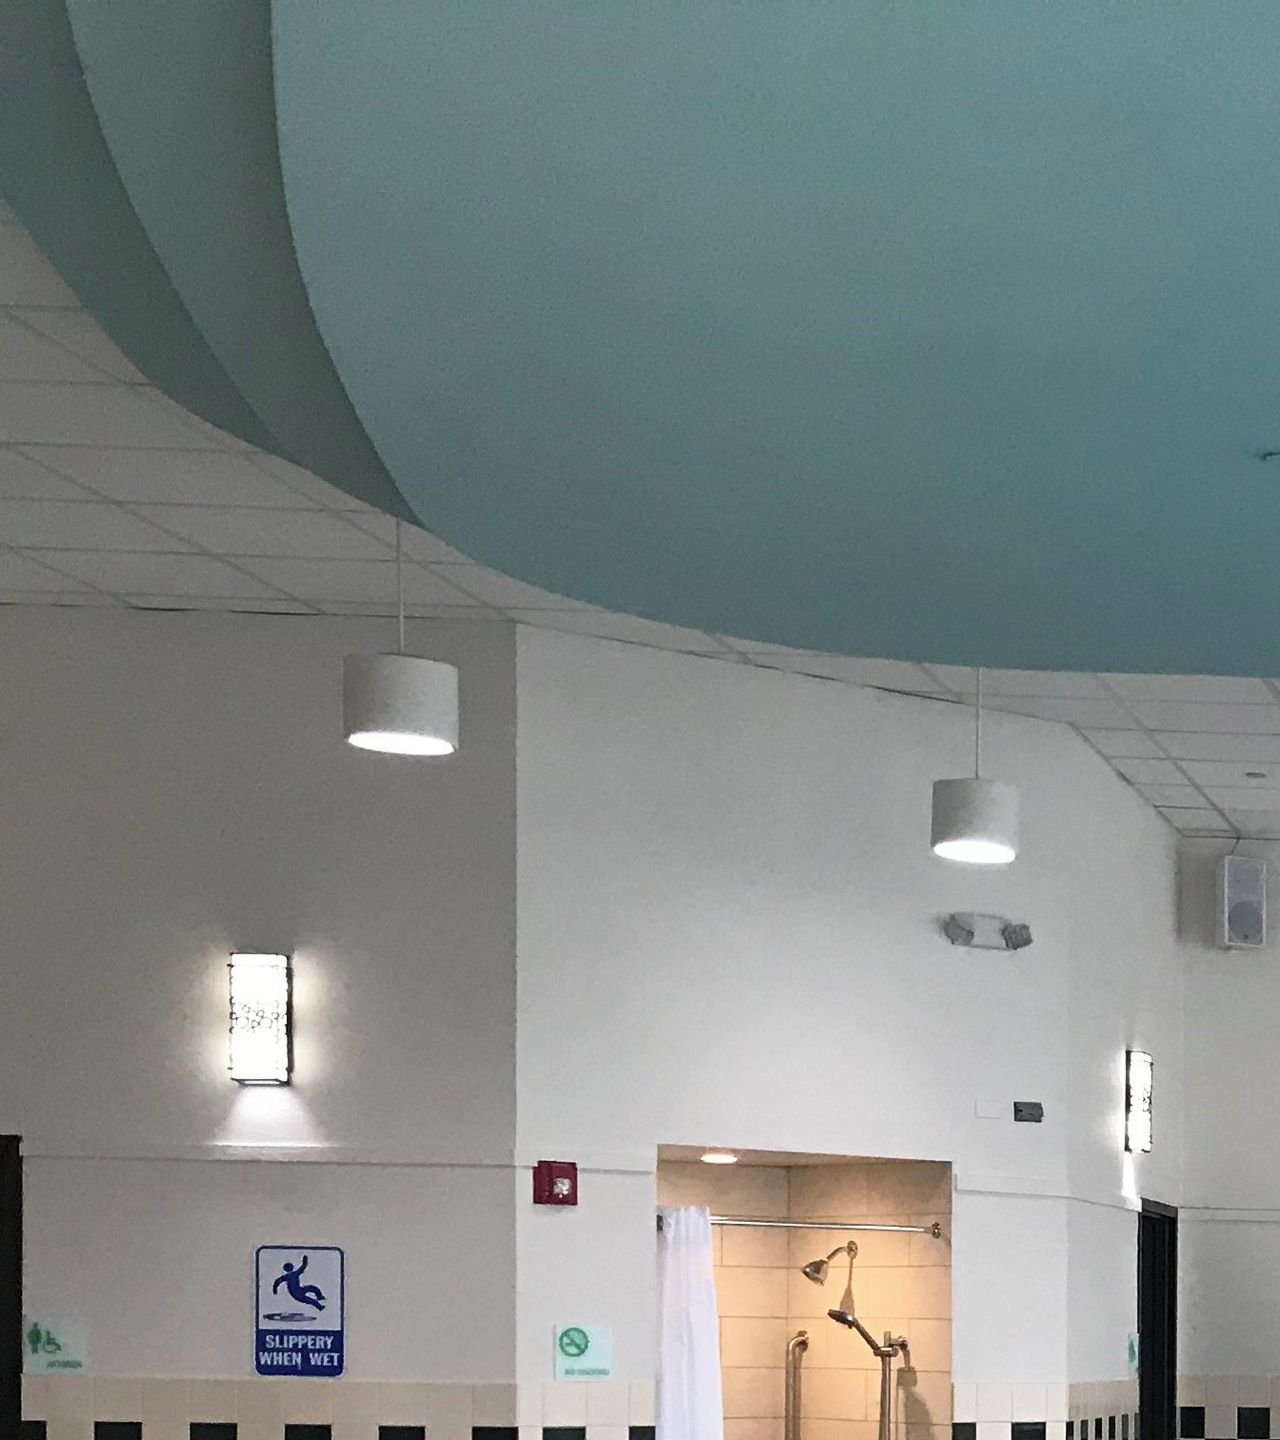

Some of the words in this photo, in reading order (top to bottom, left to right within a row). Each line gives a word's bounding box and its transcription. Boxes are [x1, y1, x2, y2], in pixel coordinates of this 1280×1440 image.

[265, 1334, 334, 1349] SLIPPERY
[259, 1351, 302, 1366] WHEN
[309, 1352, 340, 1366] WET
